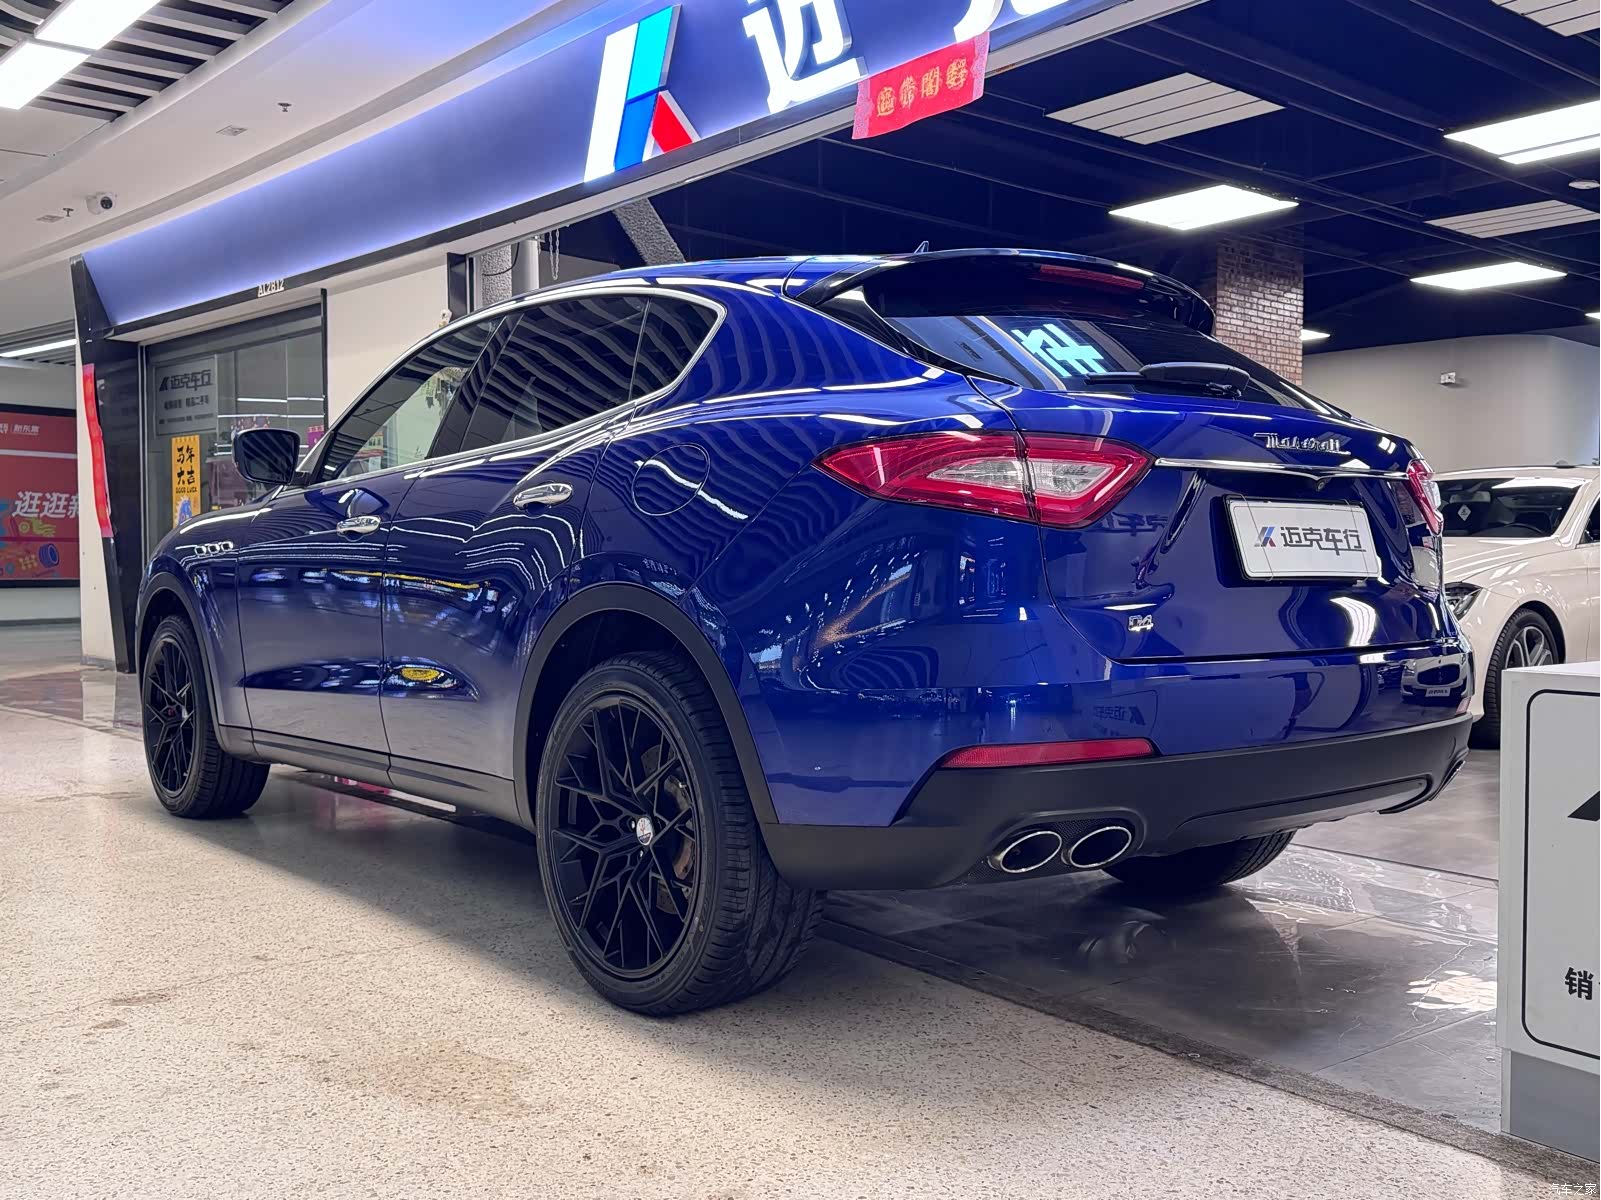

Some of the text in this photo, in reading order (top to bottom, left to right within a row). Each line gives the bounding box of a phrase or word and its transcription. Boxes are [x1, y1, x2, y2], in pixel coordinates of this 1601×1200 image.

[1280, 526, 1367, 556] 迈克车行
[1564, 967, 1600, 1001] 销
